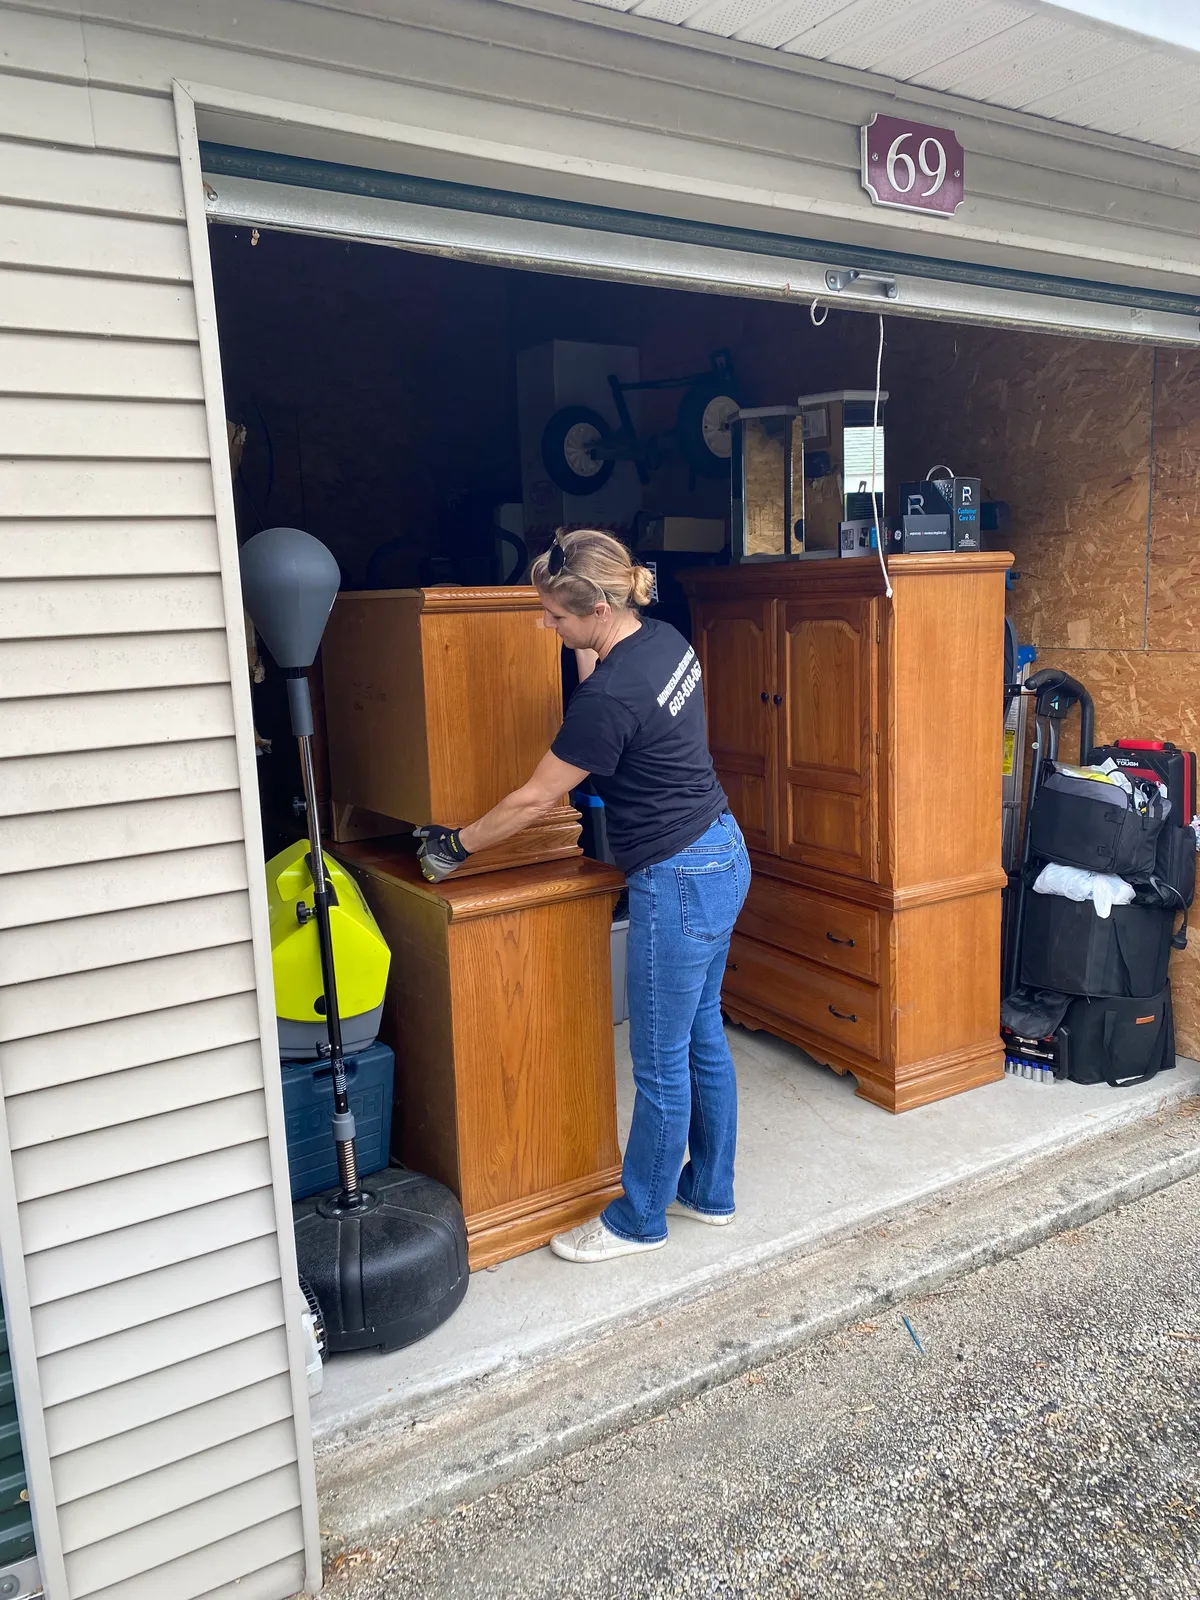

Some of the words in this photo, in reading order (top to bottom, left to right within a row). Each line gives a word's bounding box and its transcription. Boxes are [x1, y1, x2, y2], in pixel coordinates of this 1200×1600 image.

[886, 132, 947, 197] 69
[907, 494, 926, 515] R
[962, 486, 972, 501] R
[286, 1089, 381, 1135] BOCH
